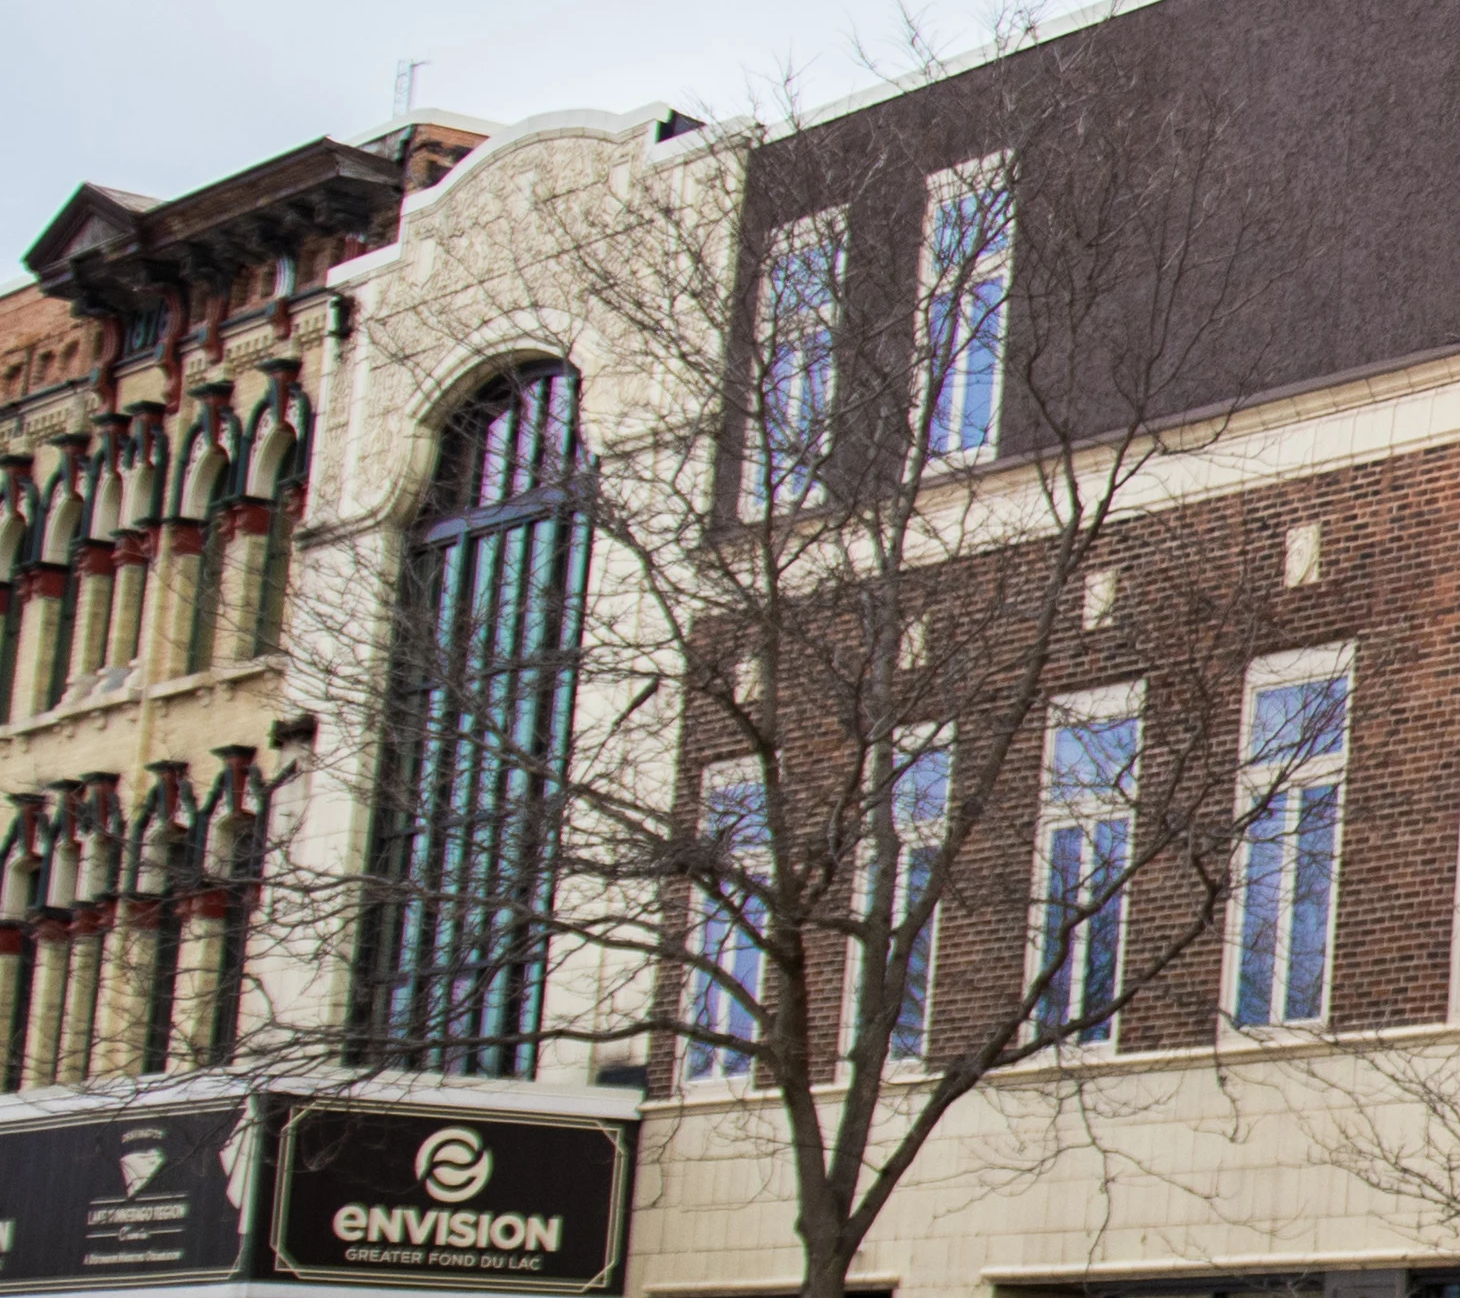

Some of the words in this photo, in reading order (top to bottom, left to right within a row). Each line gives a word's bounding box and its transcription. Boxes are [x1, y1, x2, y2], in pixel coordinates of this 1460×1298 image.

[345, 1248, 423, 1265] GREATER
[428, 1252, 476, 1268] FOND
[480, 1254, 504, 1269] DU
[508, 1255, 543, 1271] LAC
